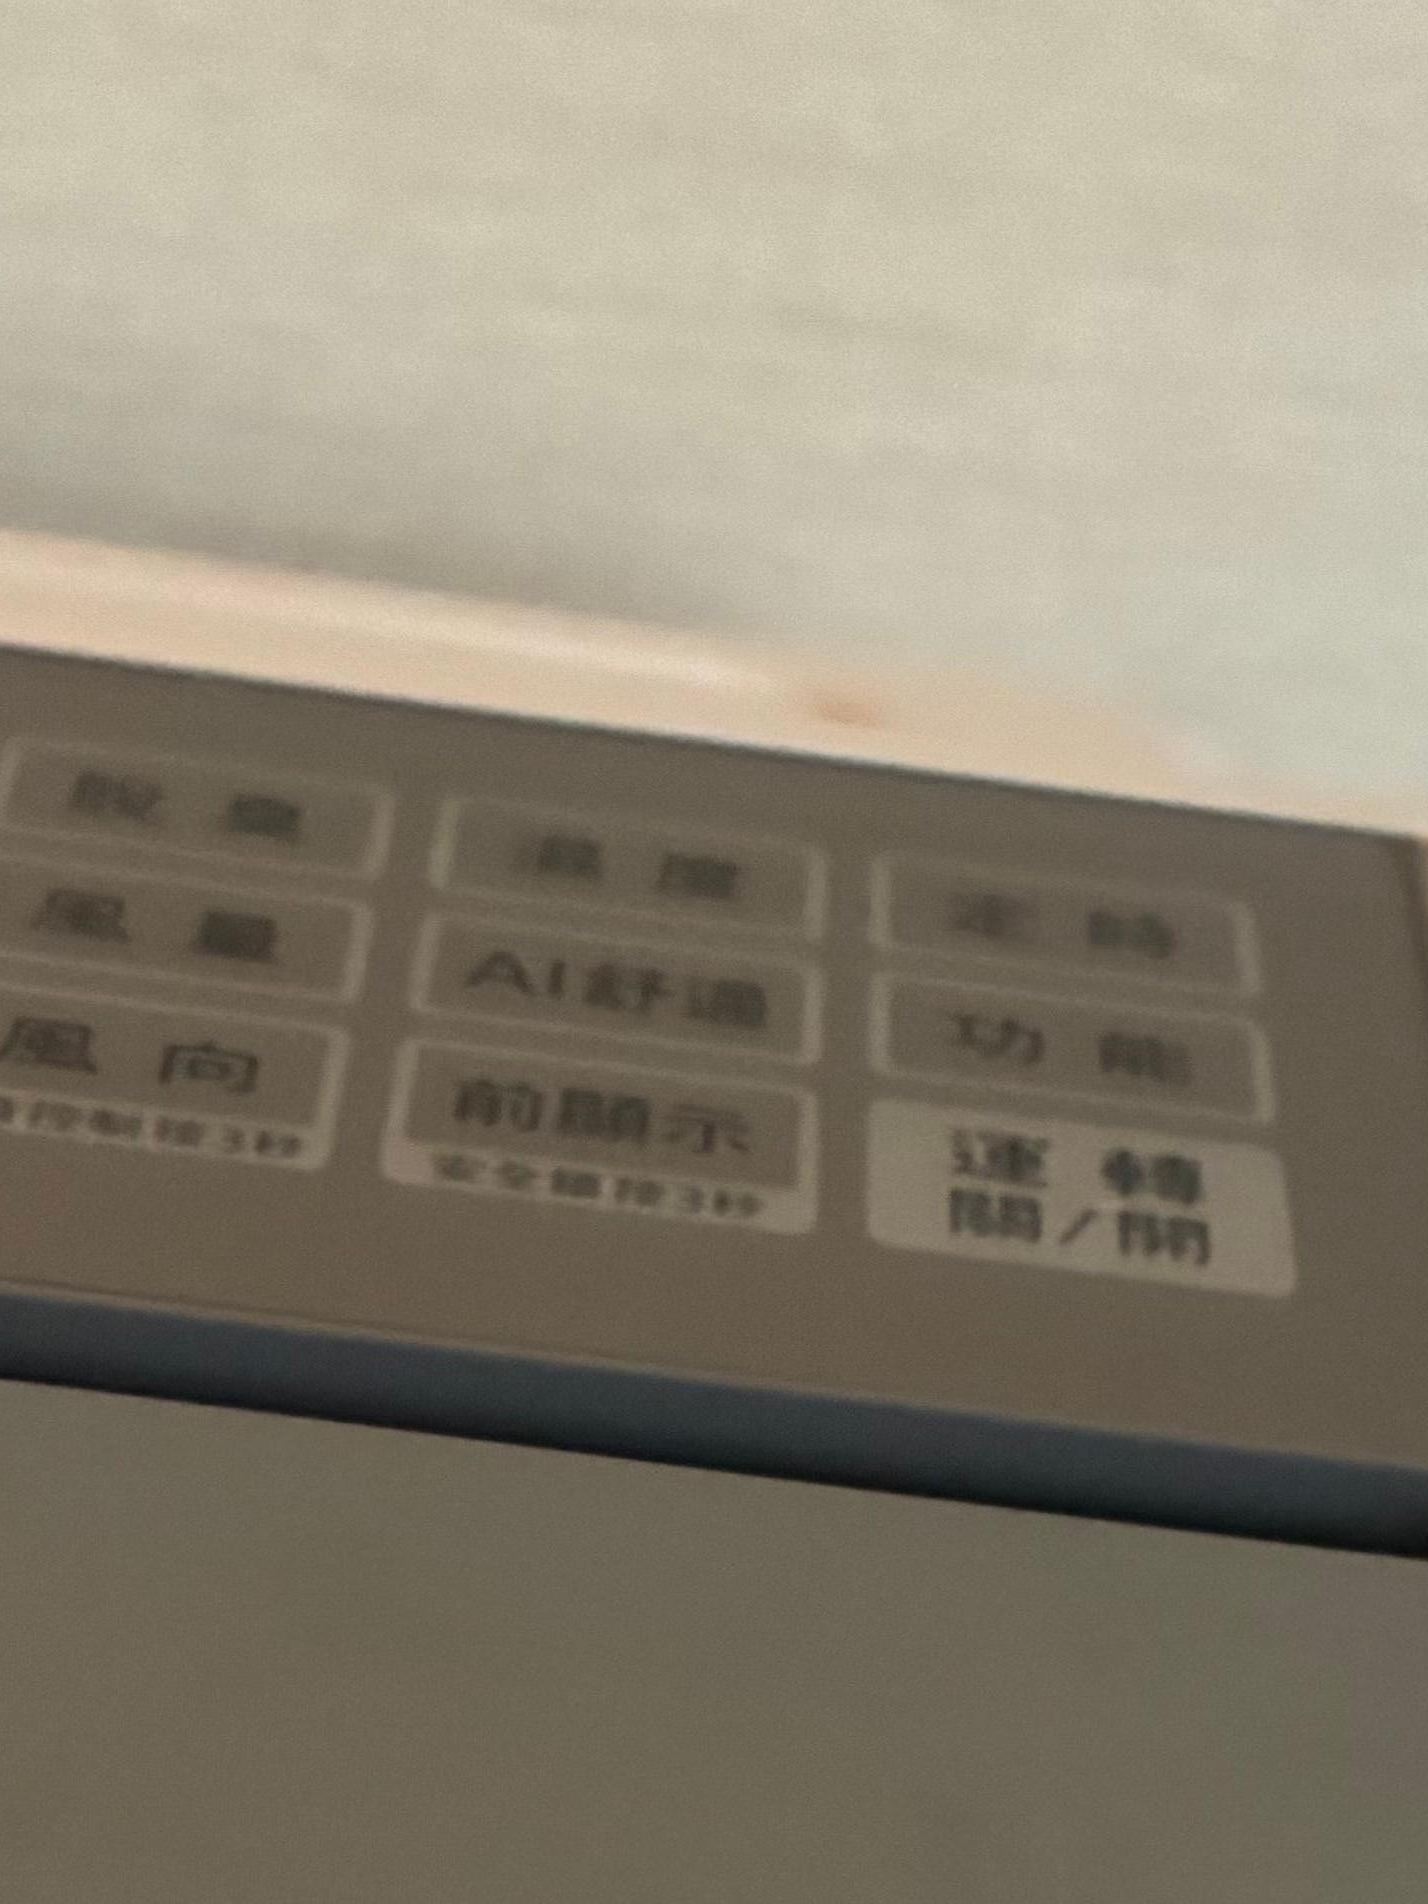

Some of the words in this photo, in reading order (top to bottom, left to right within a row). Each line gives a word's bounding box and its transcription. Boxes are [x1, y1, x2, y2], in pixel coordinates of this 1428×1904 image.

[31, 887, 280, 966] 風量
[462, 949, 768, 1029] AI舒適
[948, 1009, 1192, 1085] 功能
[452, 1074, 754, 1153] 前顯示
[948, 1127, 1204, 1205] 運轉
